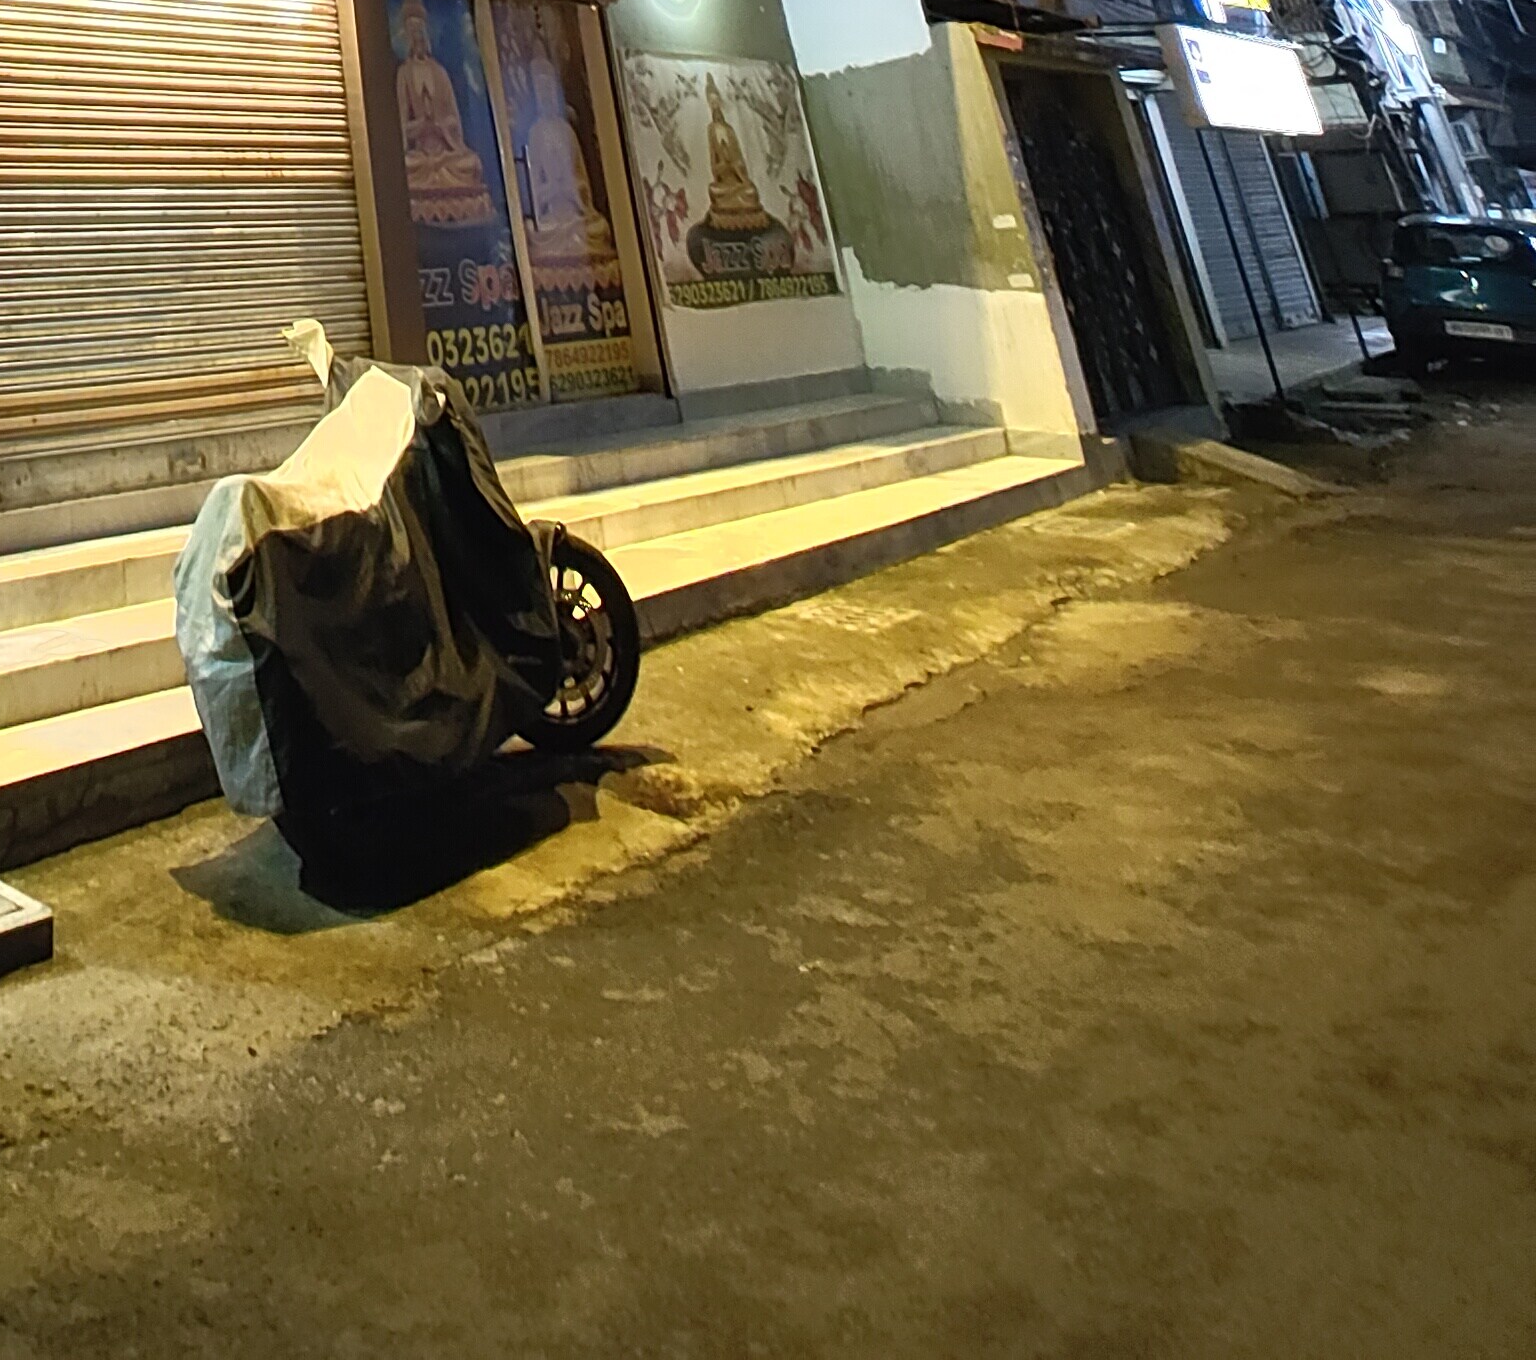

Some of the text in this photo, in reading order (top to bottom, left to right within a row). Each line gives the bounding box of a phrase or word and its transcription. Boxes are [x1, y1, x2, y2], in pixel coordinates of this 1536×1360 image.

[701, 235, 794, 276] Jazz Spa
[458, 258, 520, 311] Spa
[539, 292, 627, 338] Jazz Spa
